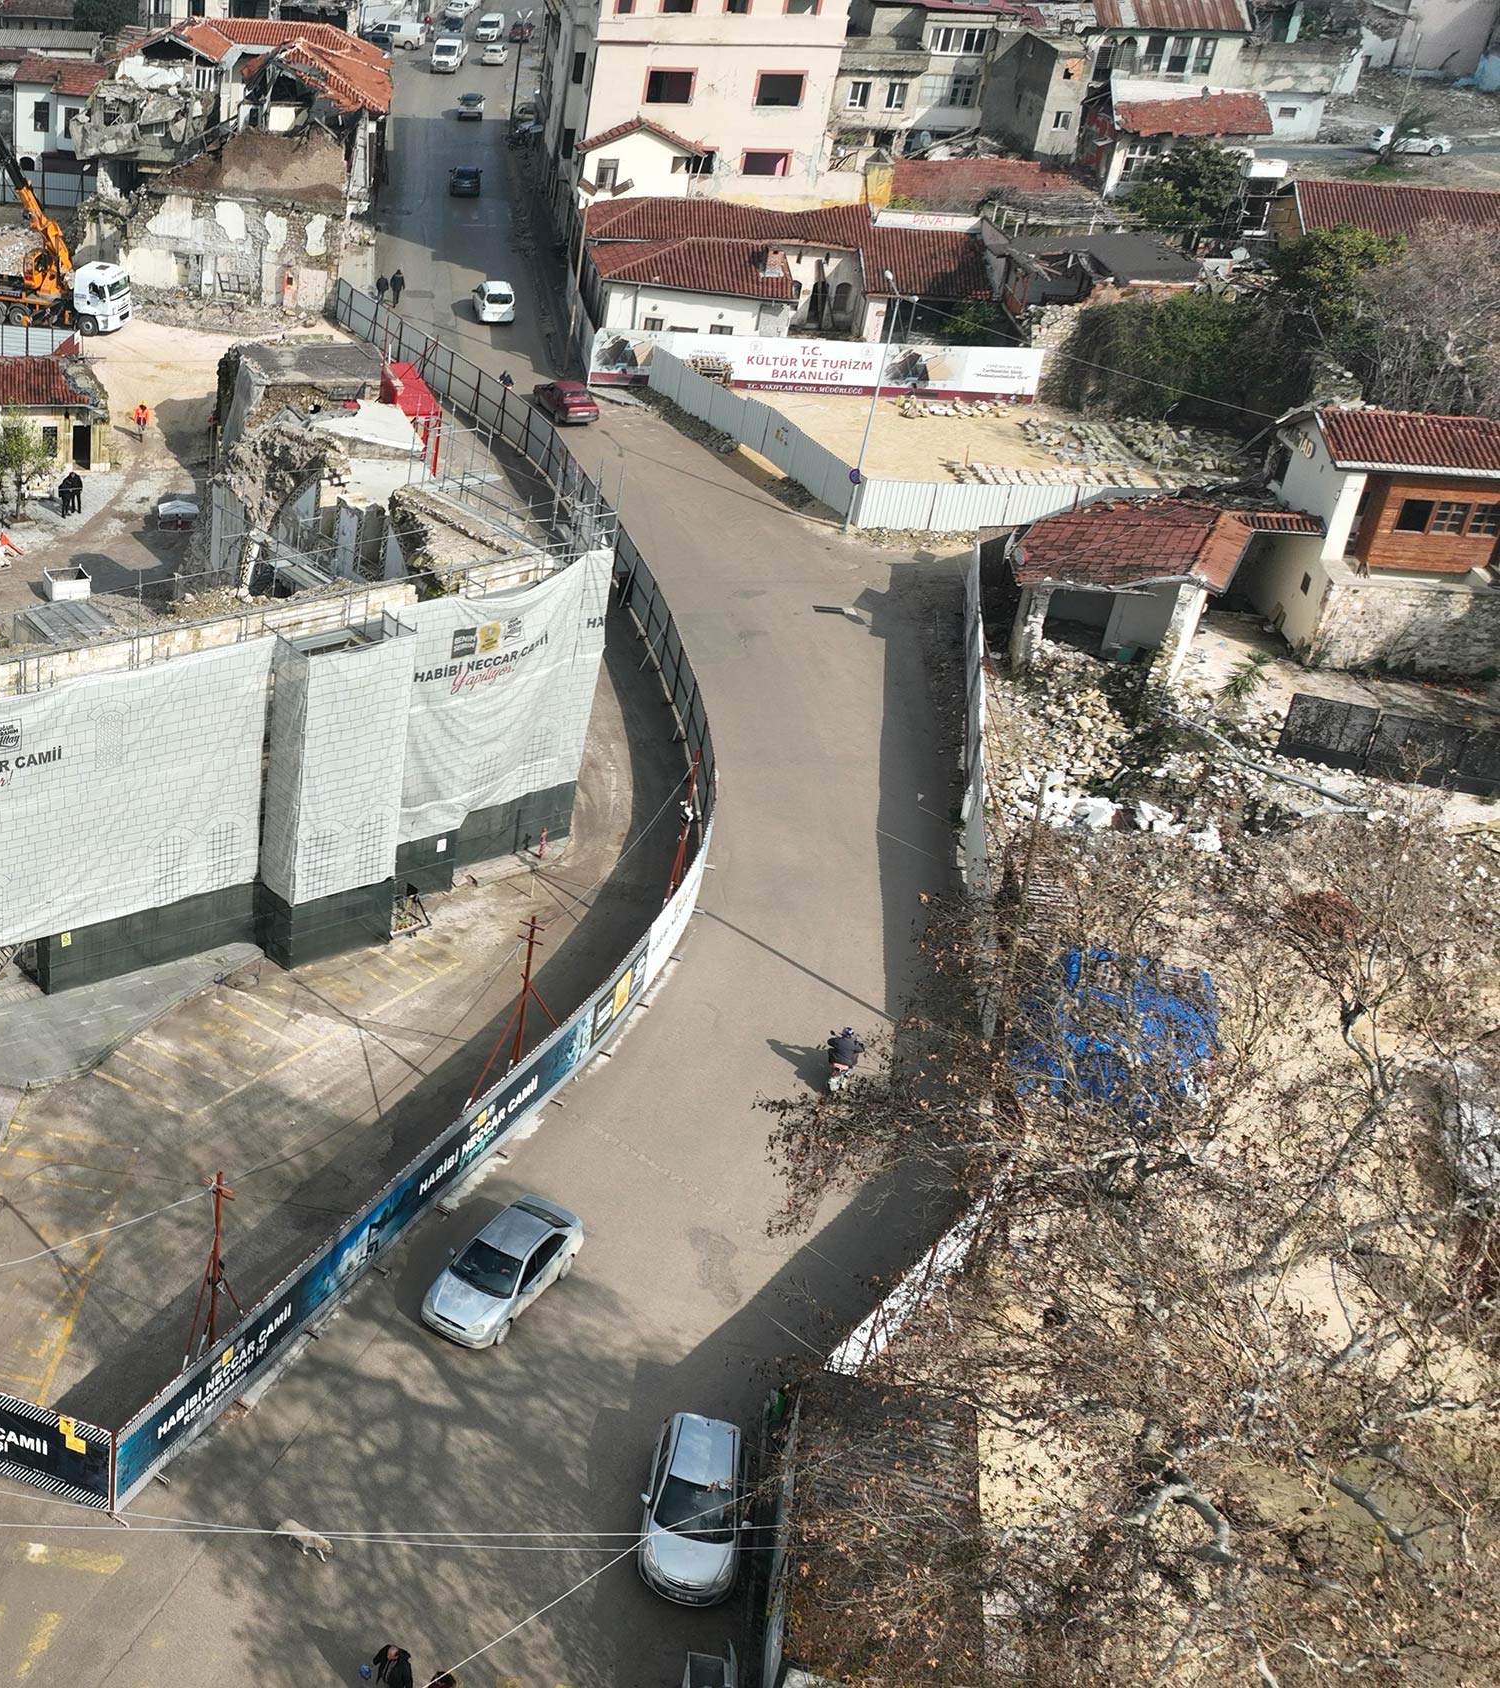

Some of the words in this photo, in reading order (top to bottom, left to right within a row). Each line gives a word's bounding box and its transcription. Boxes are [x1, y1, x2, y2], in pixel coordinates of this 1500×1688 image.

[746, 355, 798, 367] KÜLTÜR
[801, 358, 817, 368] VE
[821, 358, 872, 371] TURİZM
[801, 345, 822, 356] T.C.
[771, 369, 844, 382] BAKANLIĞI
[414, 659, 462, 683] HABİBİ
[467, 649, 522, 673] NECCAR
[15, 745, 63, 769] CAMİİ
[419, 1147, 459, 1196] HABİBİ
[461, 1107, 506, 1153] NECCAR
[507, 1074, 538, 1113] CAMİİ
[157, 1387, 202, 1440] HABİBİ
[205, 1340, 255, 1394] NECCAR
[258, 1302, 292, 1343] CAMİİ
[184, 1353, 254, 1425] RESTORASYONU
[255, 1339, 268, 1357] İŞİ
